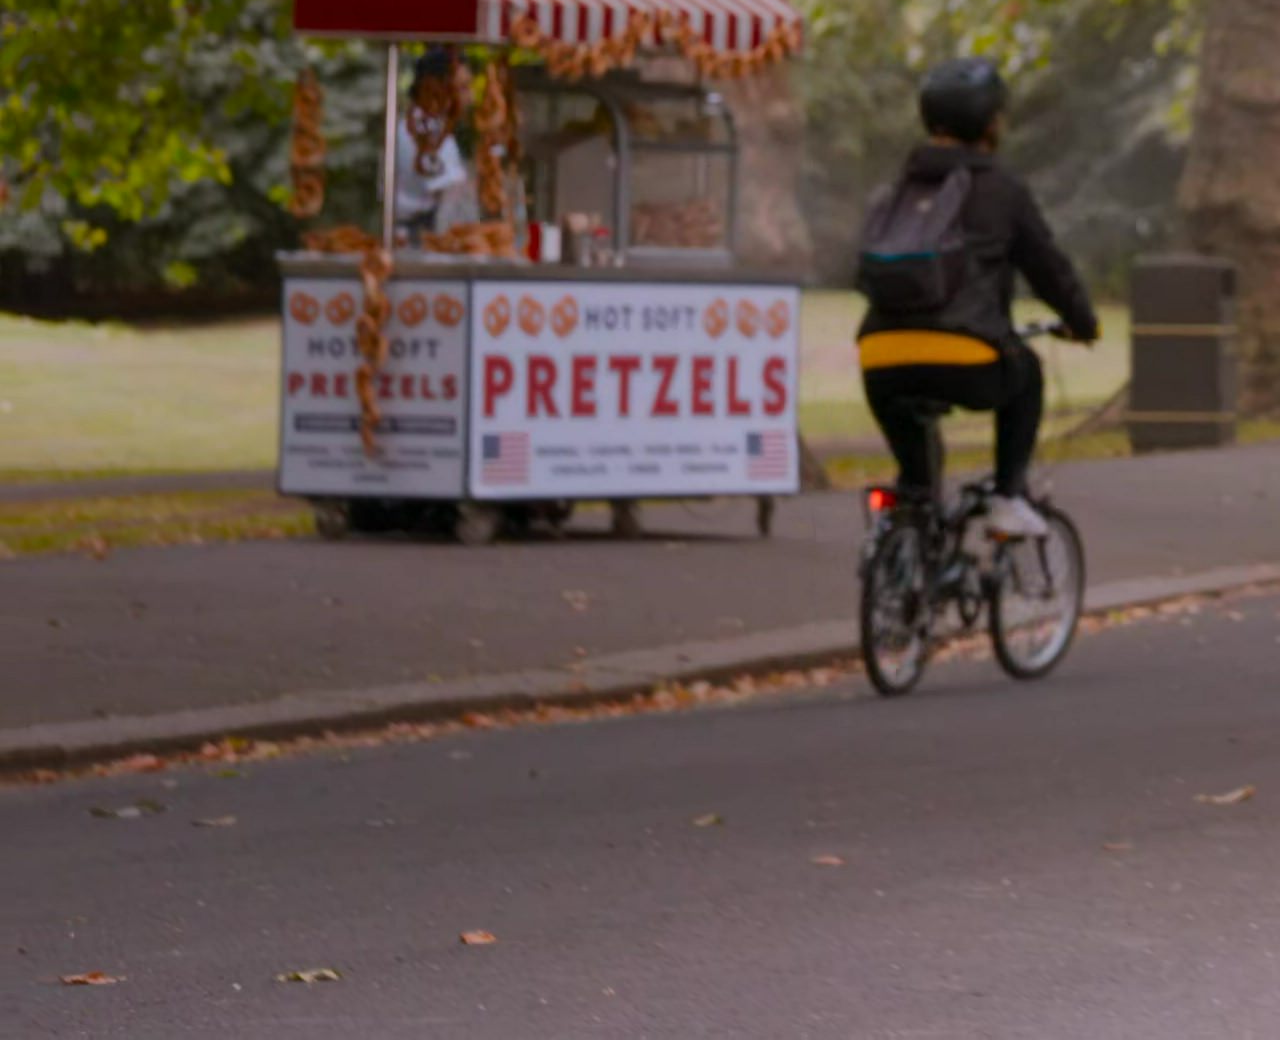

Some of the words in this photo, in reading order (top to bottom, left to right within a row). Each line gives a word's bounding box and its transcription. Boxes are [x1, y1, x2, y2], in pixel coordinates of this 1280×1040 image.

[585, 306, 635, 332] HOT
[642, 306, 698, 332] SOFT
[377, 338, 441, 359] OFT
[287, 373, 458, 400] PREZELS
[482, 355, 788, 418] PRETZELS
